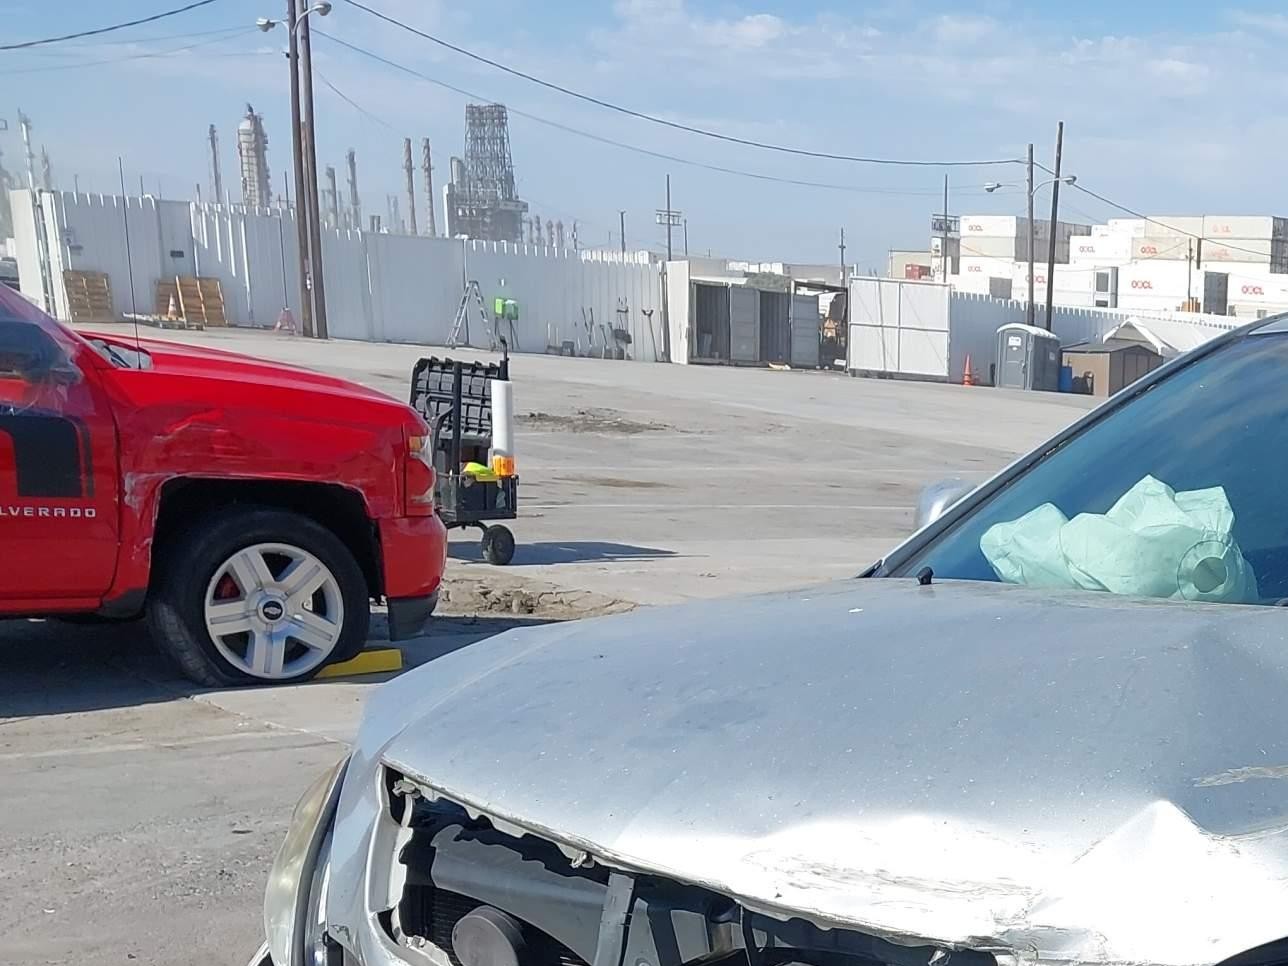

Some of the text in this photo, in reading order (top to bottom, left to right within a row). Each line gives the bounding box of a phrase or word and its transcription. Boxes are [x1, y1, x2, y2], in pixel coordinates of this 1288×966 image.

[1025, 274, 1047, 284] OCL
[1131, 280, 1153, 289] OOCL
[1241, 285, 1265, 295] OOCL
